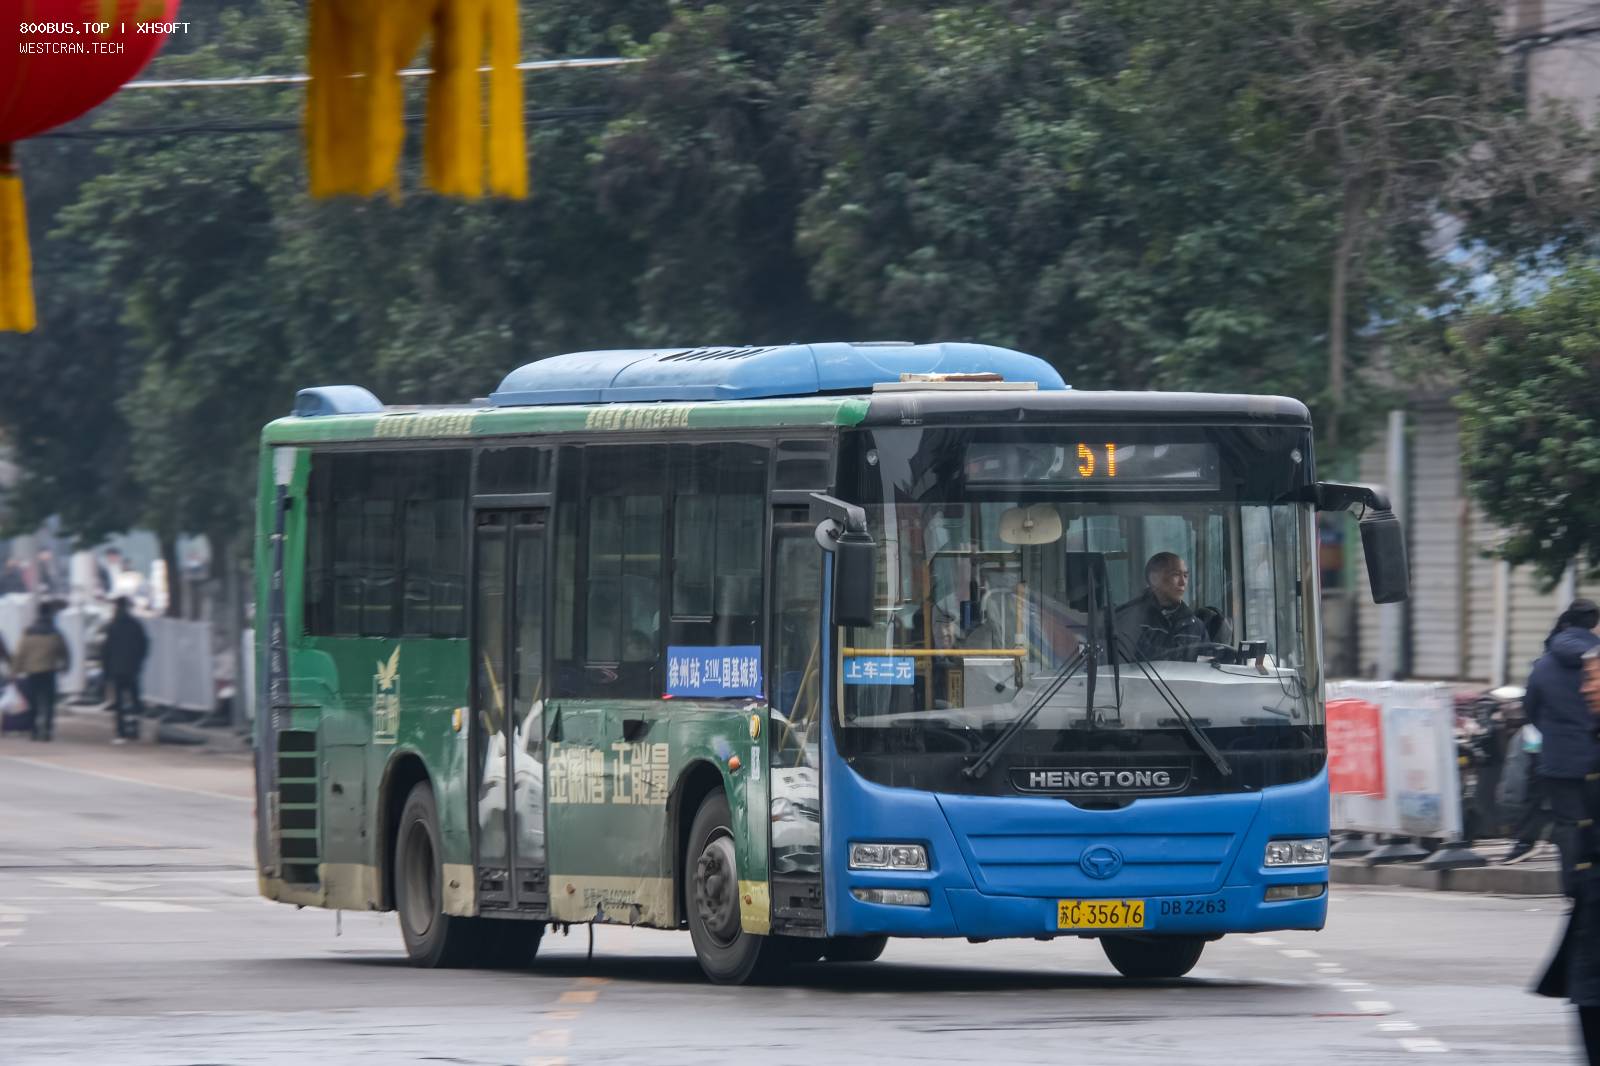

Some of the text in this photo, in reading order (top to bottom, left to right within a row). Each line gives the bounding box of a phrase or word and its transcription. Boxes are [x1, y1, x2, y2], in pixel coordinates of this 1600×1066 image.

[1077, 443, 1118, 477] 51
[669, 657, 758, 688] 徐州站 51W 国基城邦
[846, 661, 912, 679] 上车二元
[612, 743, 669, 804] 正能量
[1029, 771, 1170, 788] HENGTONG
